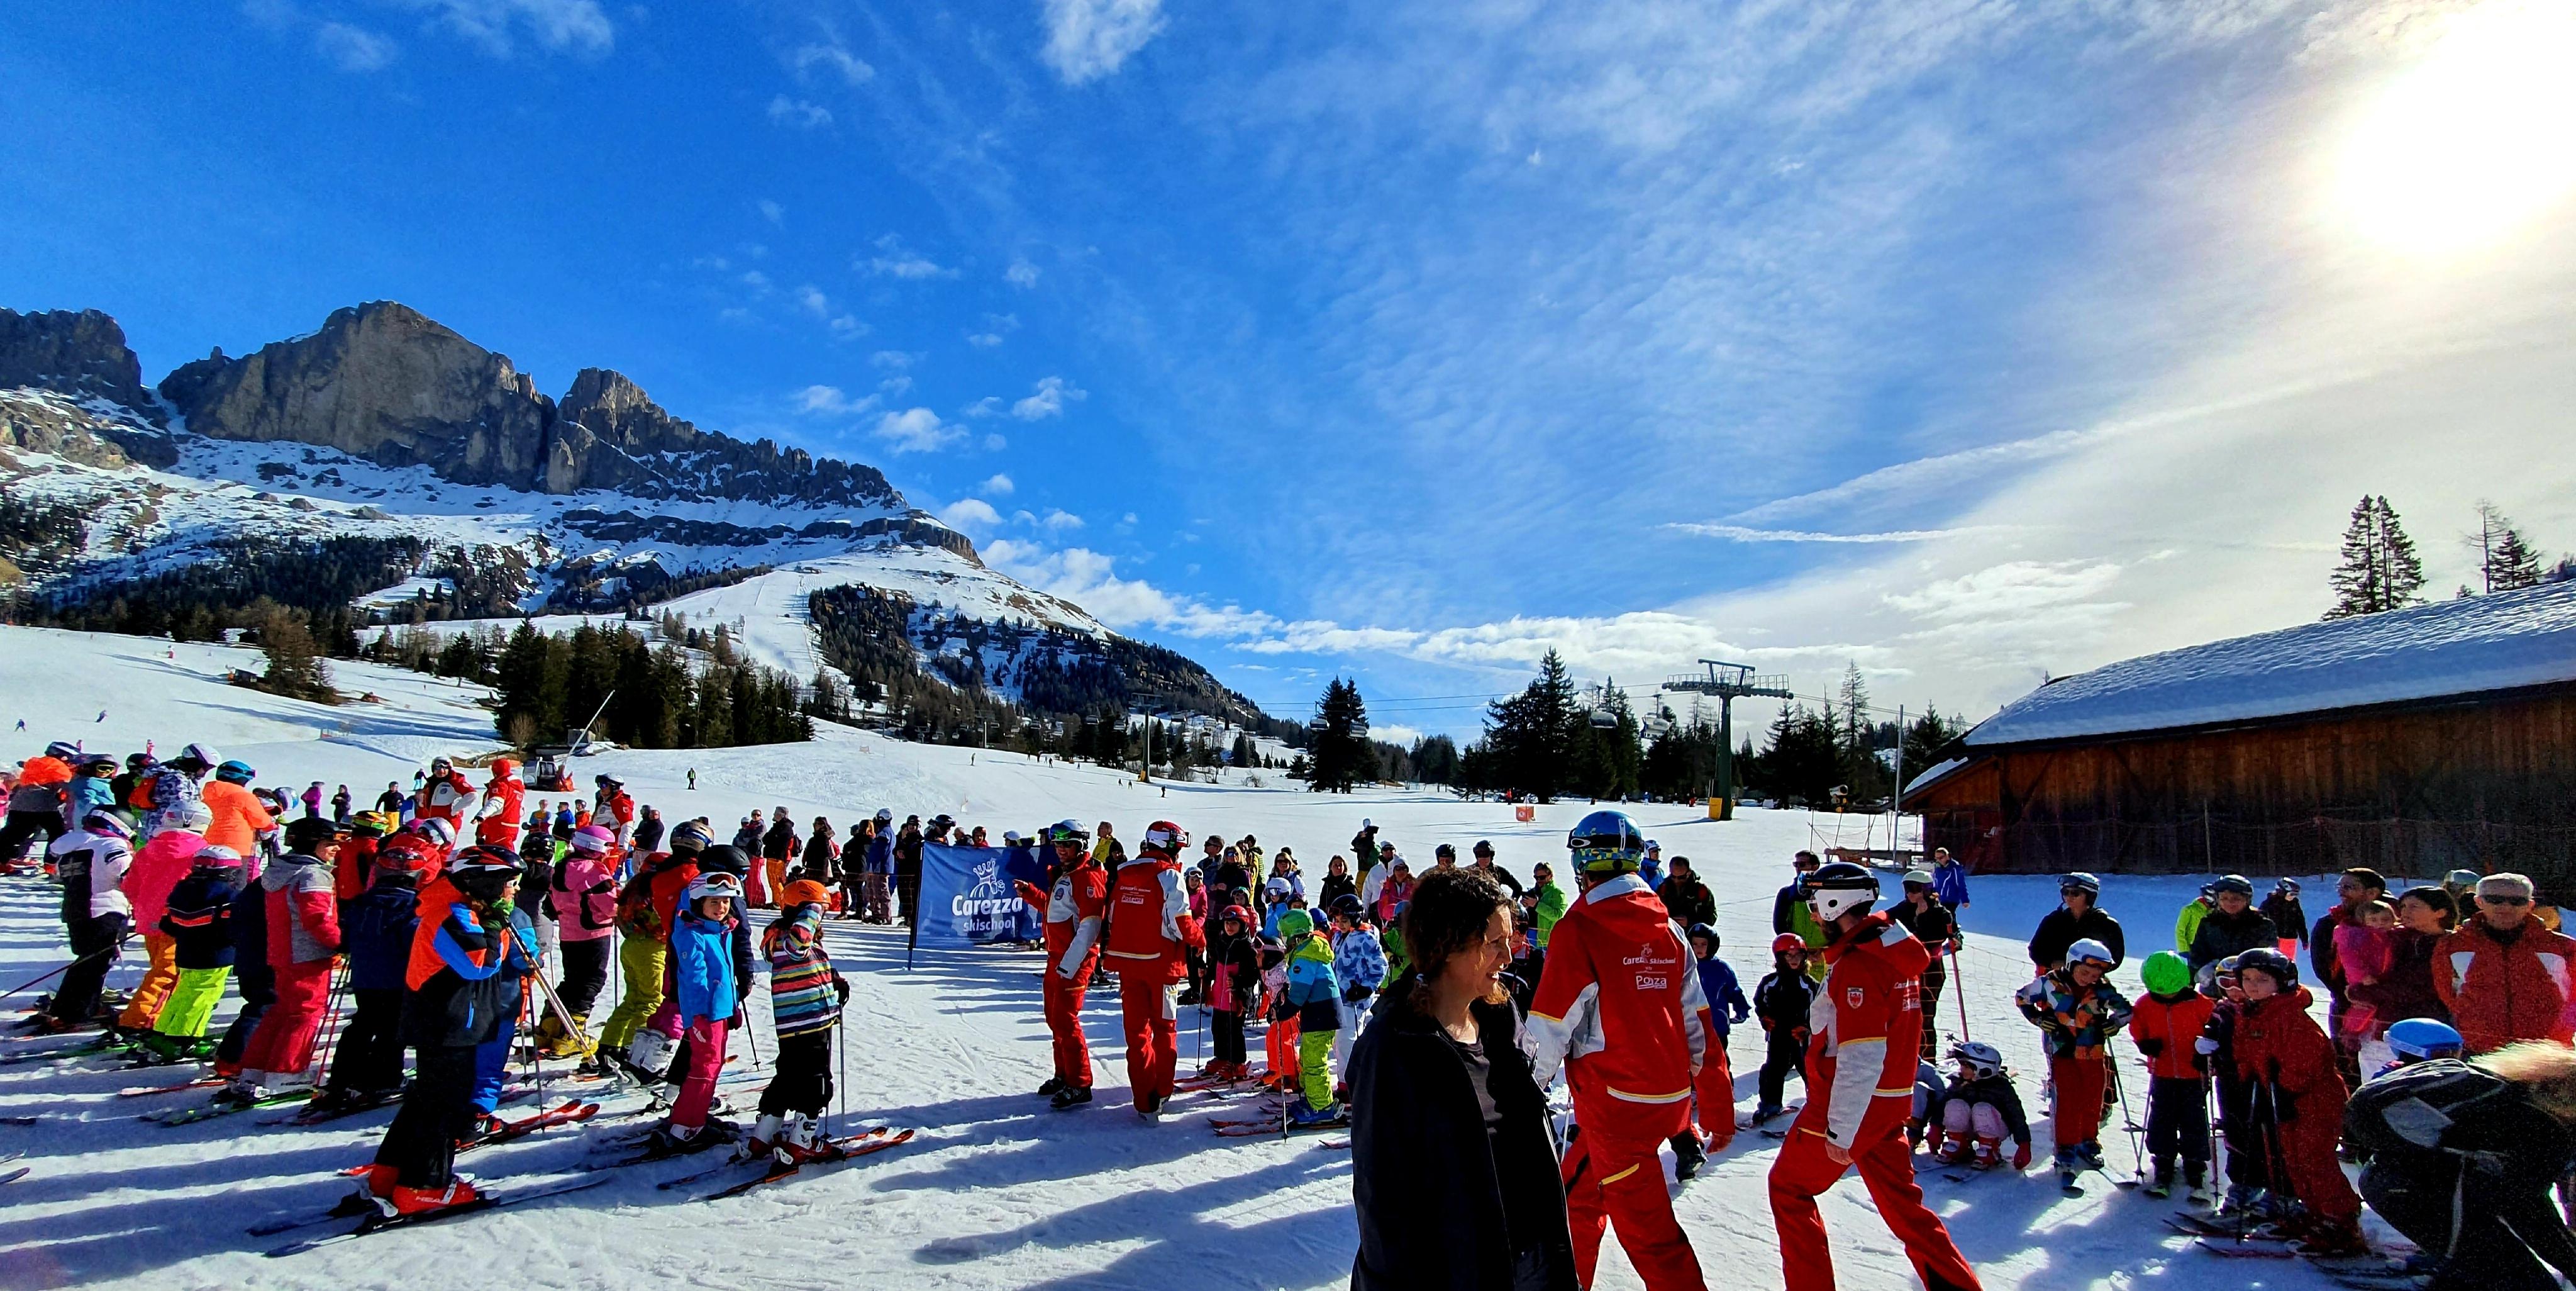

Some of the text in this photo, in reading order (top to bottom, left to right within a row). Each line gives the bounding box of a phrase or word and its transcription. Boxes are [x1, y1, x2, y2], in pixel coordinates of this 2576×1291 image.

[952, 895, 1023, 916] Carezza
[963, 915, 1016, 932] skischool
[1623, 956, 1648, 965] Carez
[415, 1195, 443, 1204] HEA
